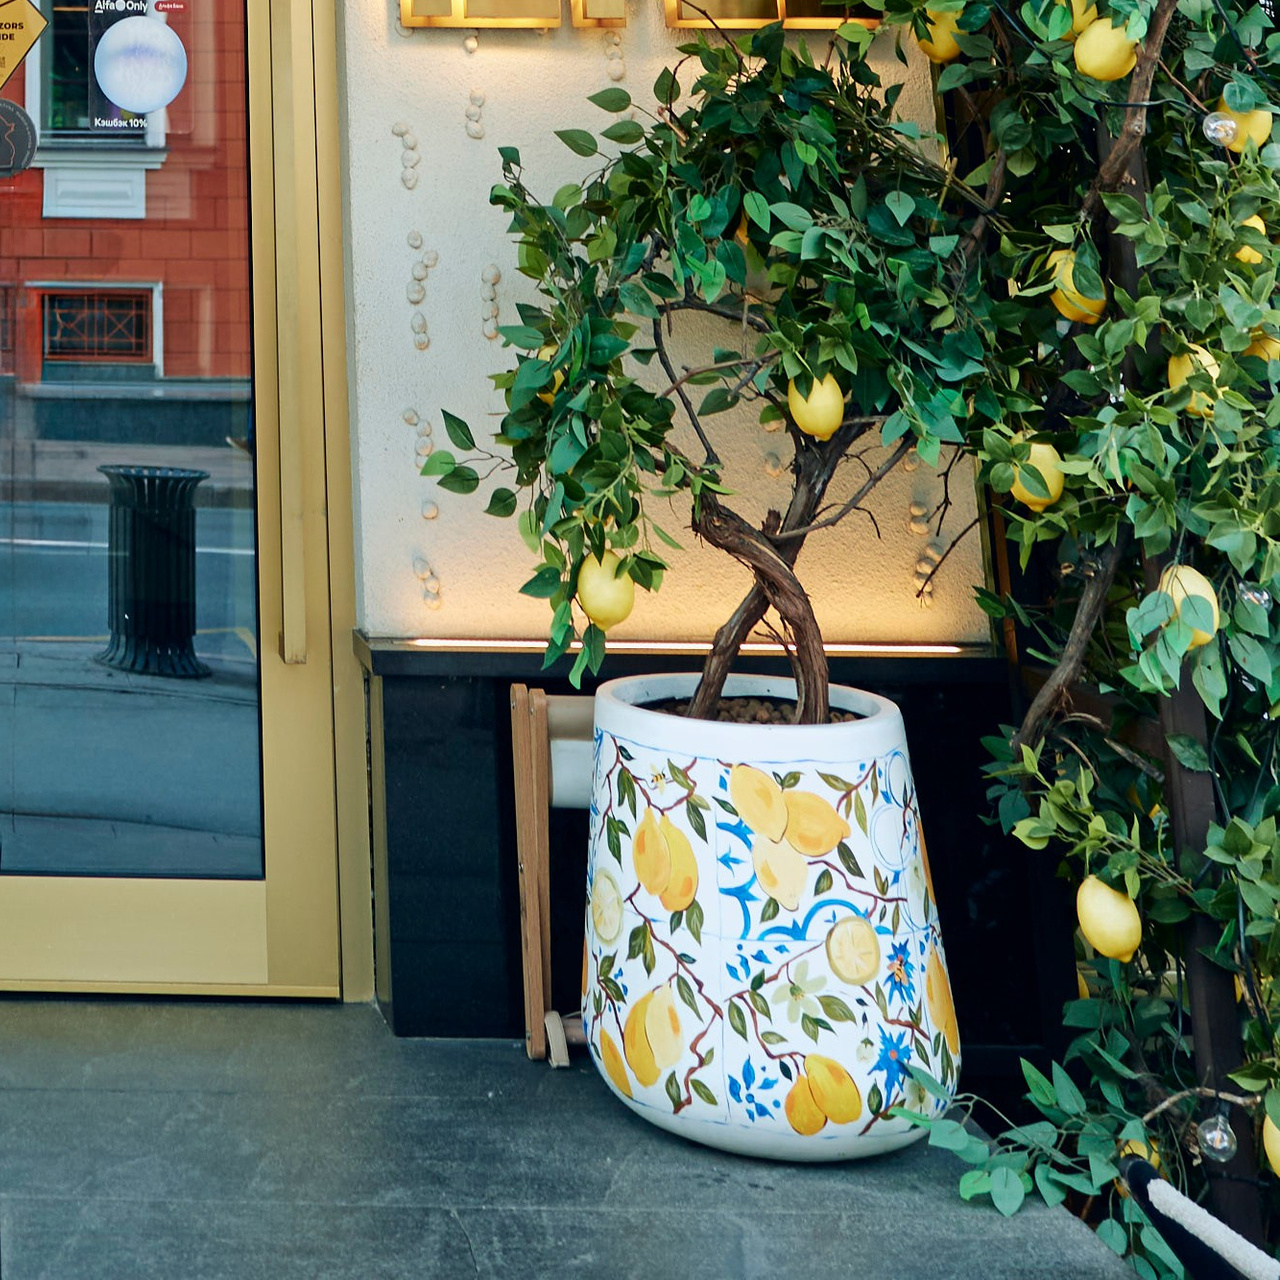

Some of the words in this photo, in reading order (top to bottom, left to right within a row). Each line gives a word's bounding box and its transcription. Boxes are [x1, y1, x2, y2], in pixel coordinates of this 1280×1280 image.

[126, 0, 148, 13] Only
[94, 117, 128, 128] Кэшбэк
[128, 118, 148, 128] 10%
